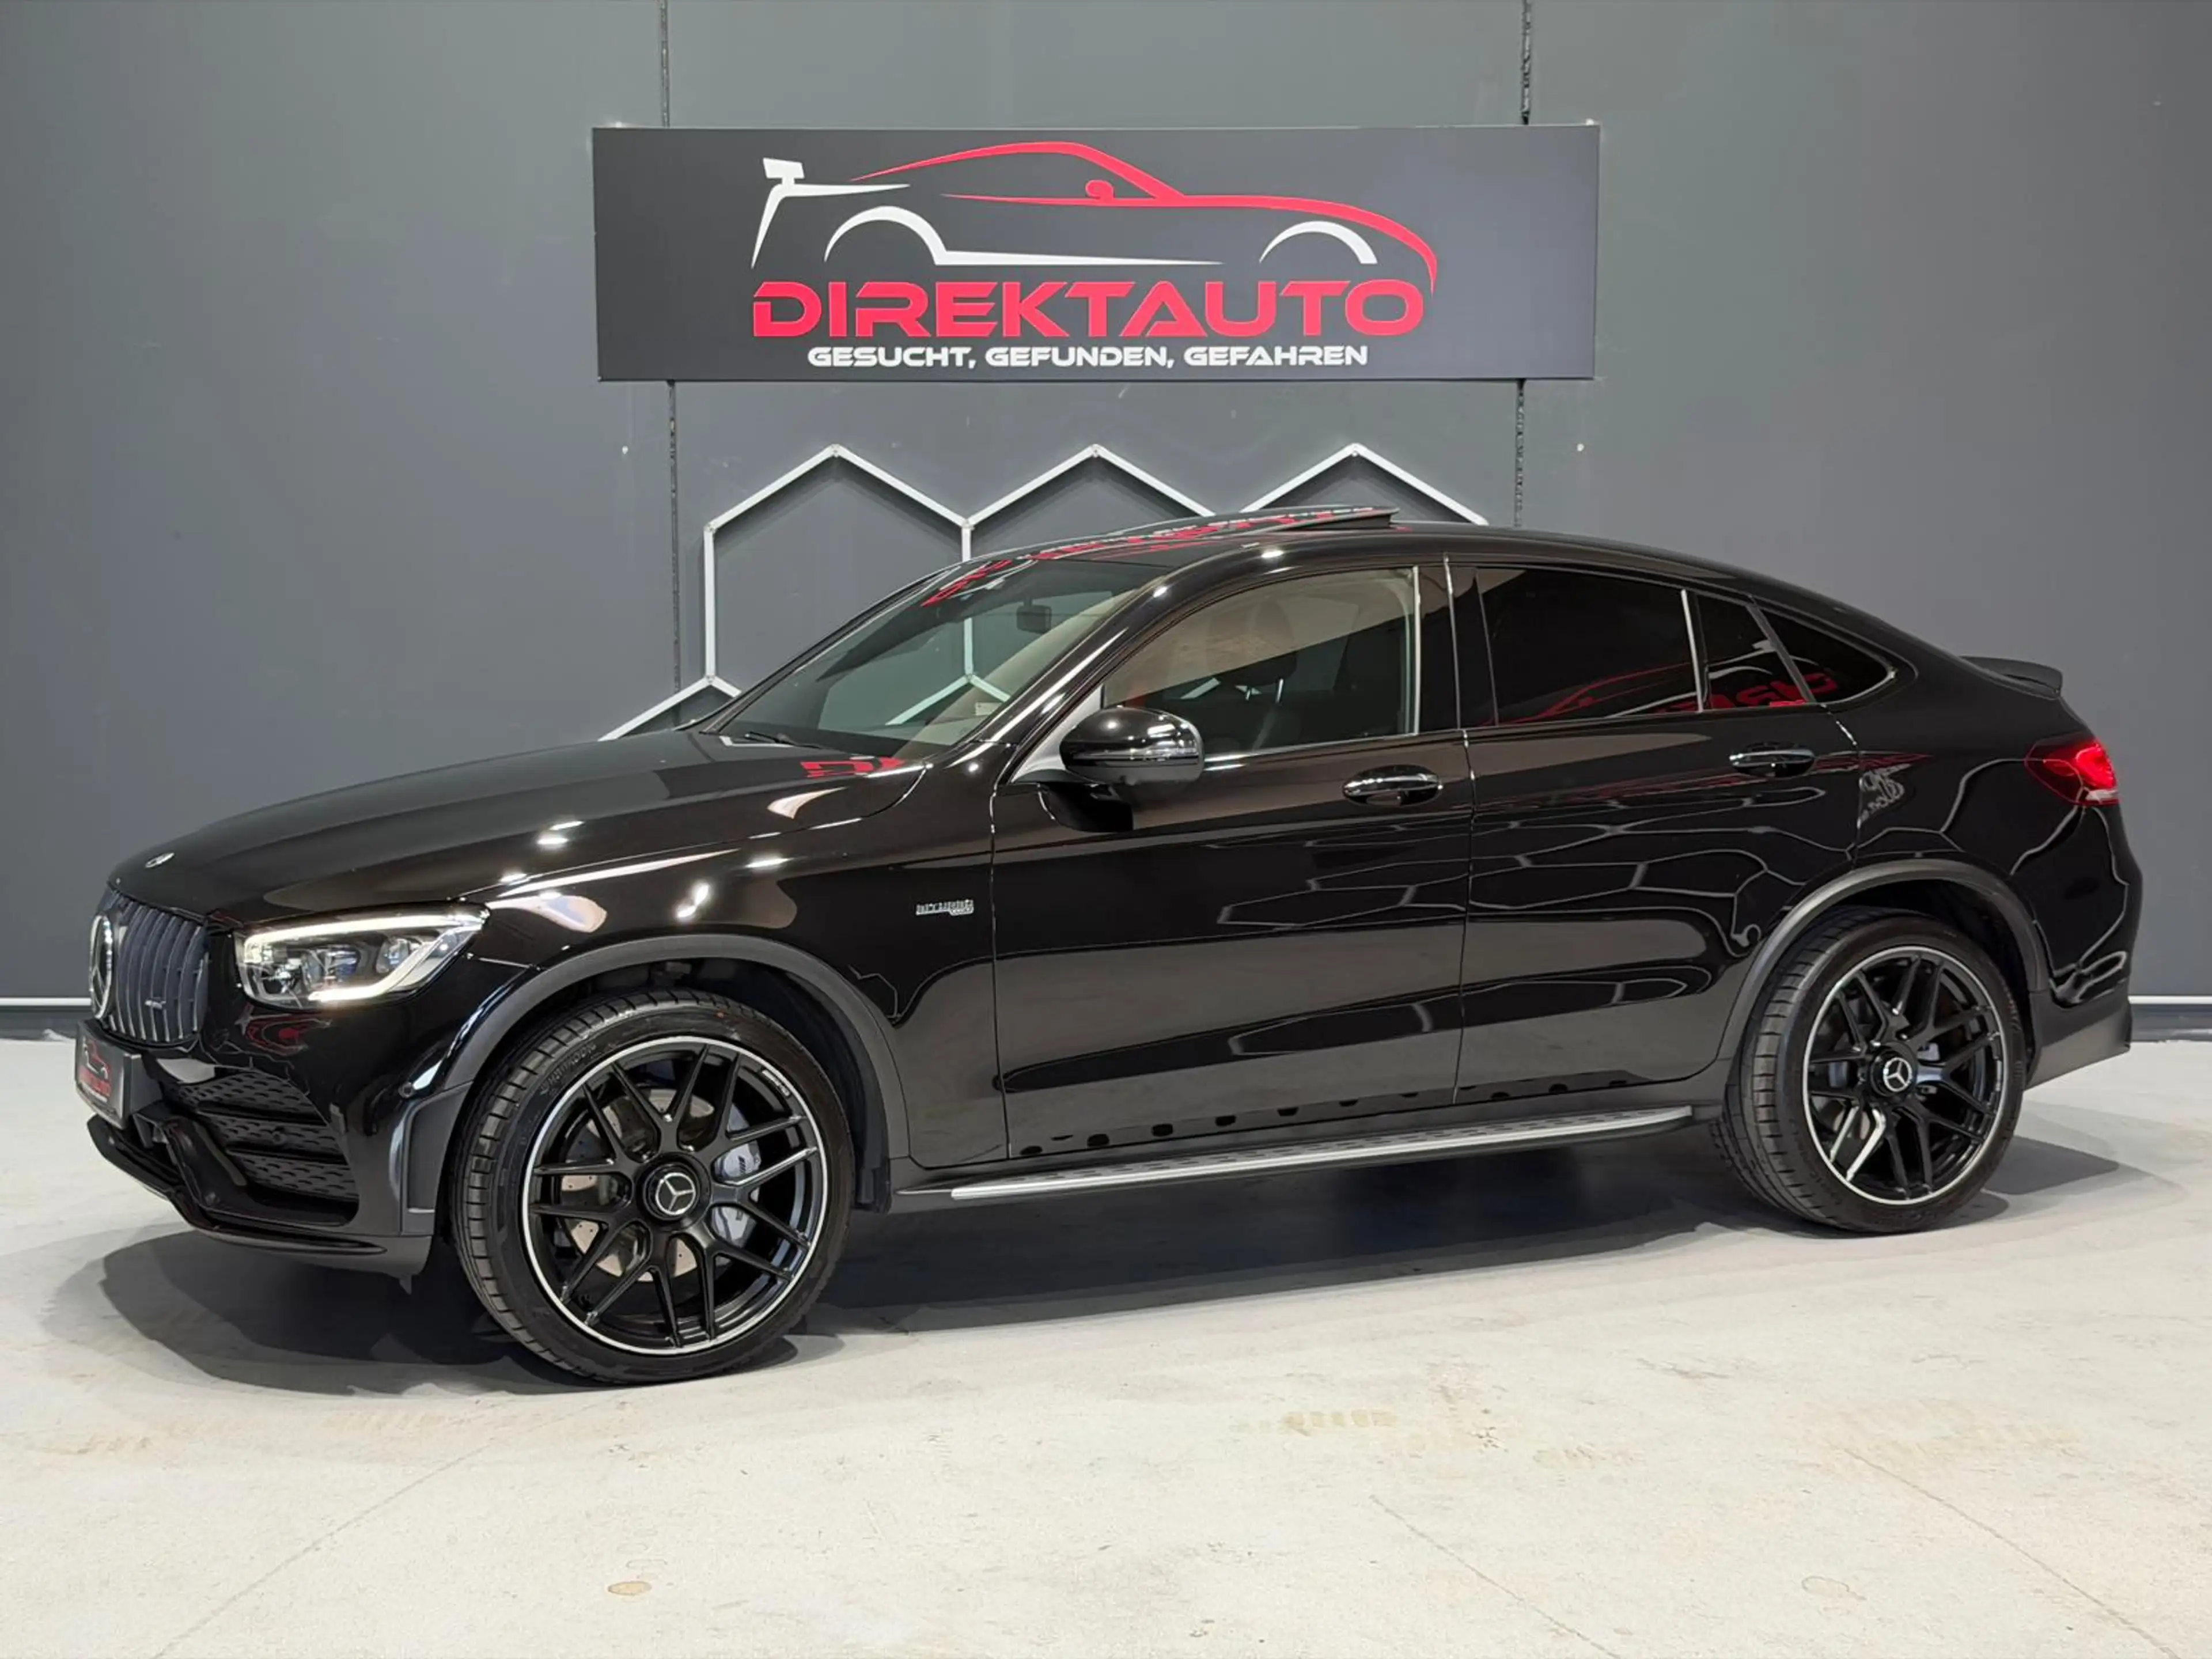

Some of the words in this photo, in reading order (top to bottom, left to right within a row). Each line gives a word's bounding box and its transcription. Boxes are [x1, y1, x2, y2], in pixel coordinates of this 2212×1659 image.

[752, 280, 1425, 339] DIREKTAUTO
[808, 346, 976, 369] GESUCHT,
[984, 346, 1175, 369] GEFUNDEN,
[1183, 345, 1368, 366] GEFAHREN
